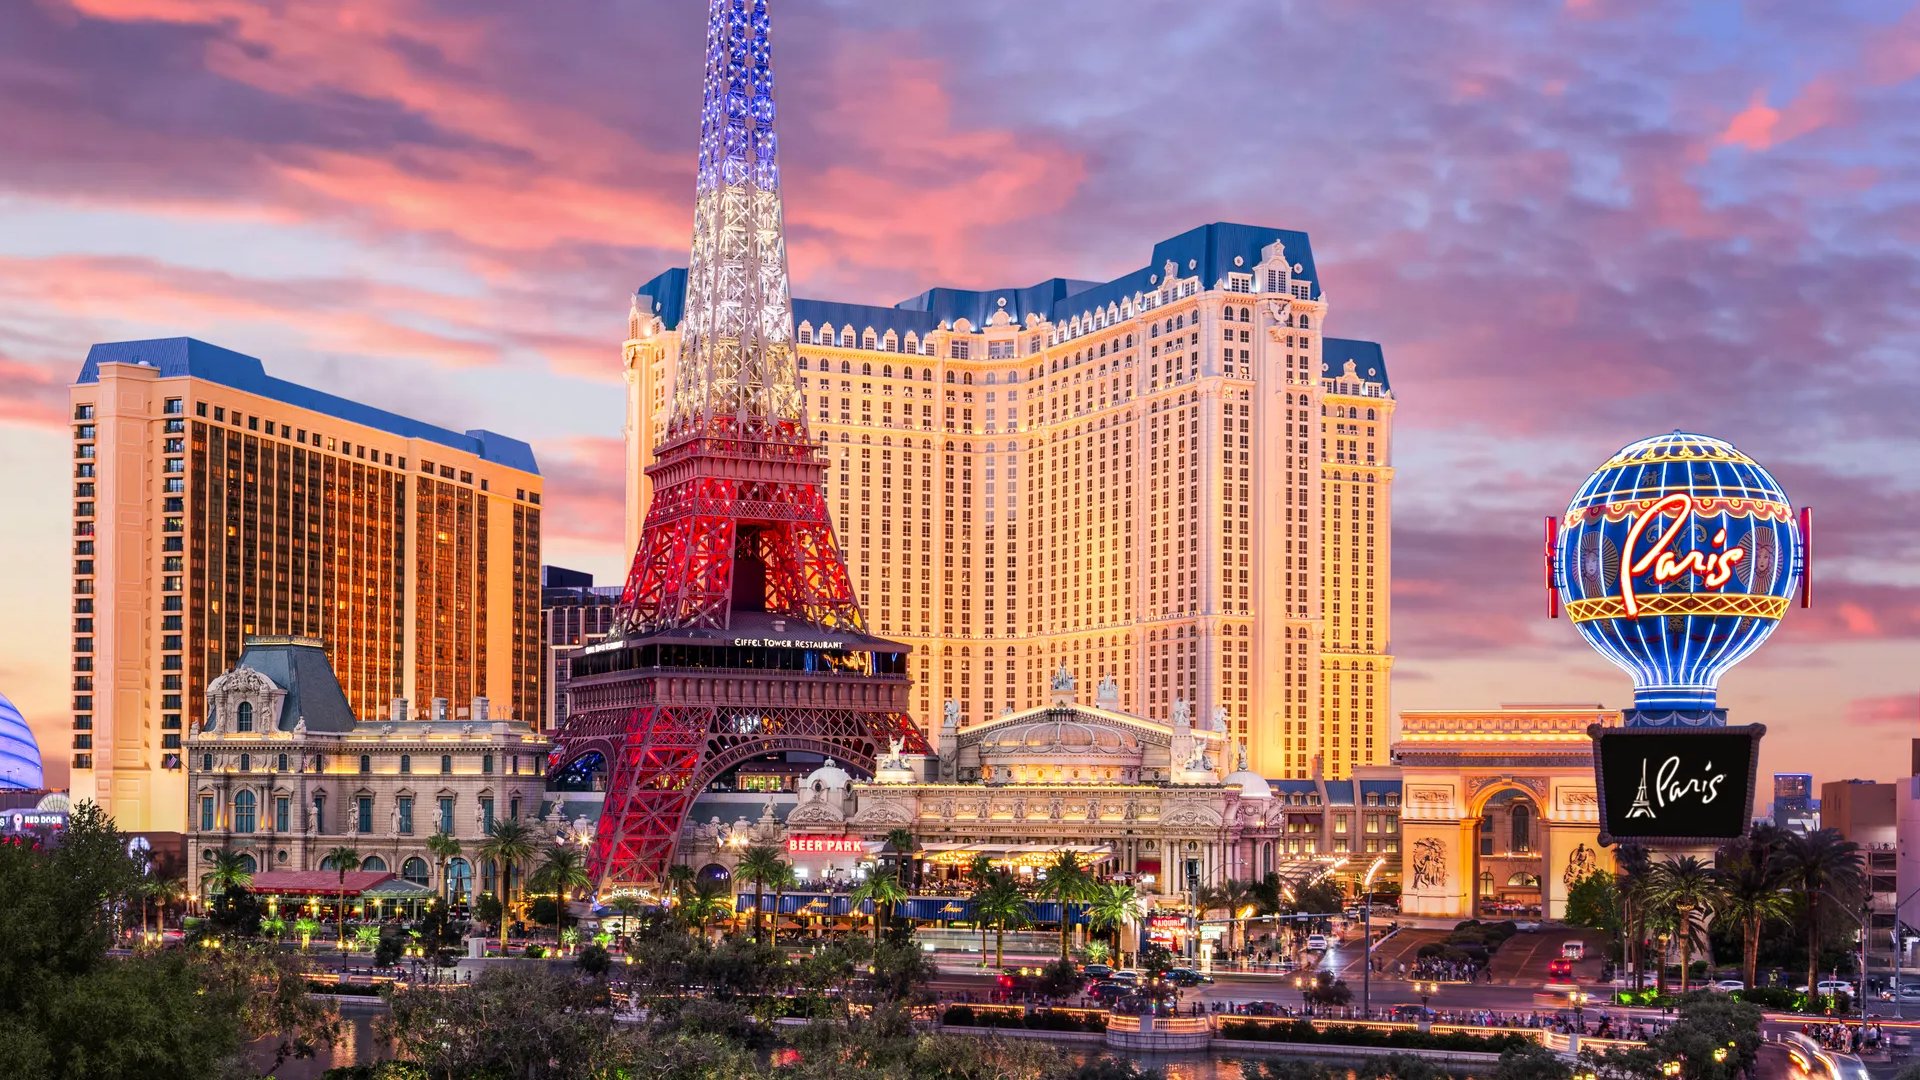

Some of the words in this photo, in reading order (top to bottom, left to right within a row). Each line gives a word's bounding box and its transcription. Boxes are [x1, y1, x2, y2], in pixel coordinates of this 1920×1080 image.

[1620, 493, 1745, 620] Paris
[734, 638, 761, 647] EIFFEL
[763, 638, 792, 648] TOWER
[795, 640, 843, 649] RESTAURANT
[1656, 756, 1724, 807] Paris
[24, 816, 39, 824] RED
[41, 816, 62, 824] DOOR
[789, 839, 823, 852] BEER
[827, 840, 862, 852] PARK
